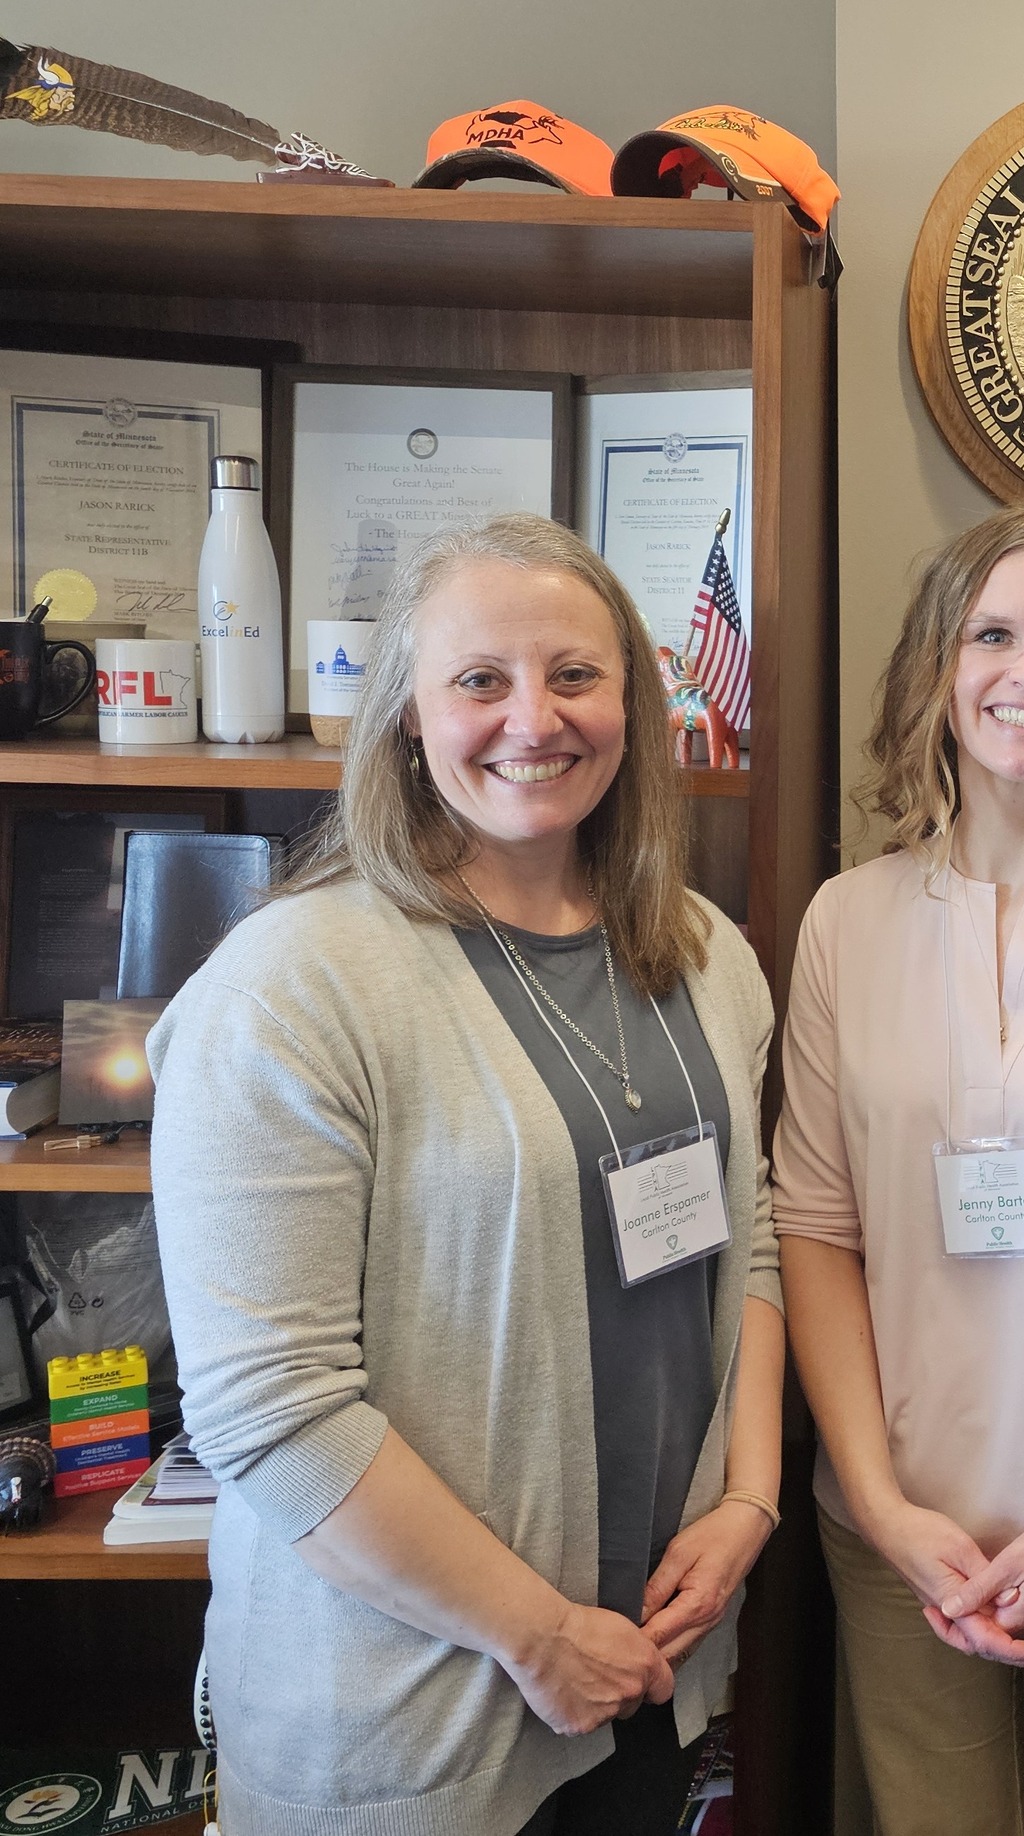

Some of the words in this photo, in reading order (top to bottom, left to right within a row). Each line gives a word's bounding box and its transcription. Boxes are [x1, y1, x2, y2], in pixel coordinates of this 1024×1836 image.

[467, 127, 524, 144] MDHA
[961, 293, 1024, 425] GREAT
[82, 430, 105, 439] State
[48, 459, 115, 472] CERTIFICATE
[117, 463, 131, 472] OF
[133, 464, 184, 475] ELECTION
[344, 461, 366, 473] The
[367, 462, 400, 473] House
[402, 463, 411, 473] is
[413, 463, 450, 476] Making
[452, 464, 469, 474] the
[470, 465, 503, 475] Senate
[392, 477, 422, 488] Great
[423, 478, 456, 490] Again!
[78, 500, 113, 511] JASON
[115, 502, 156, 512] RARICK
[355, 494, 433, 508] Congratulations
[436, 496, 454, 506] and
[456, 497, 479, 506] Best
[480, 497, 494, 507] of
[623, 498, 669, 507] CERTIFICATE
[669, 498, 680, 506] OF
[681, 497, 719, 506] ELECTION
[346, 509, 372, 520] Luck
[374, 510, 385, 520] to
[386, 512, 393, 520] a
[395, 510, 439, 521] GREAT
[645, 542, 667, 552] JASON
[95, 670, 173, 706] RFL
[622, 1208, 661, 1232] Joanne
[663, 1189, 711, 1216] Erspamer
[958, 1198, 994, 1211] Jenny
[641, 1221, 670, 1239] Carlton
[671, 1211, 698, 1228] County
[965, 1214, 996, 1223] Carlton
[79, 1369, 121, 1382] INCREASE
[82, 1394, 118, 1406] EXPAND
[88, 1421, 114, 1431] BUILD
[81, 1443, 124, 1456] PRESERVE
[81, 1467, 125, 1481] REPLICATE
[100, 1808, 180, 1833] NATIONAL
